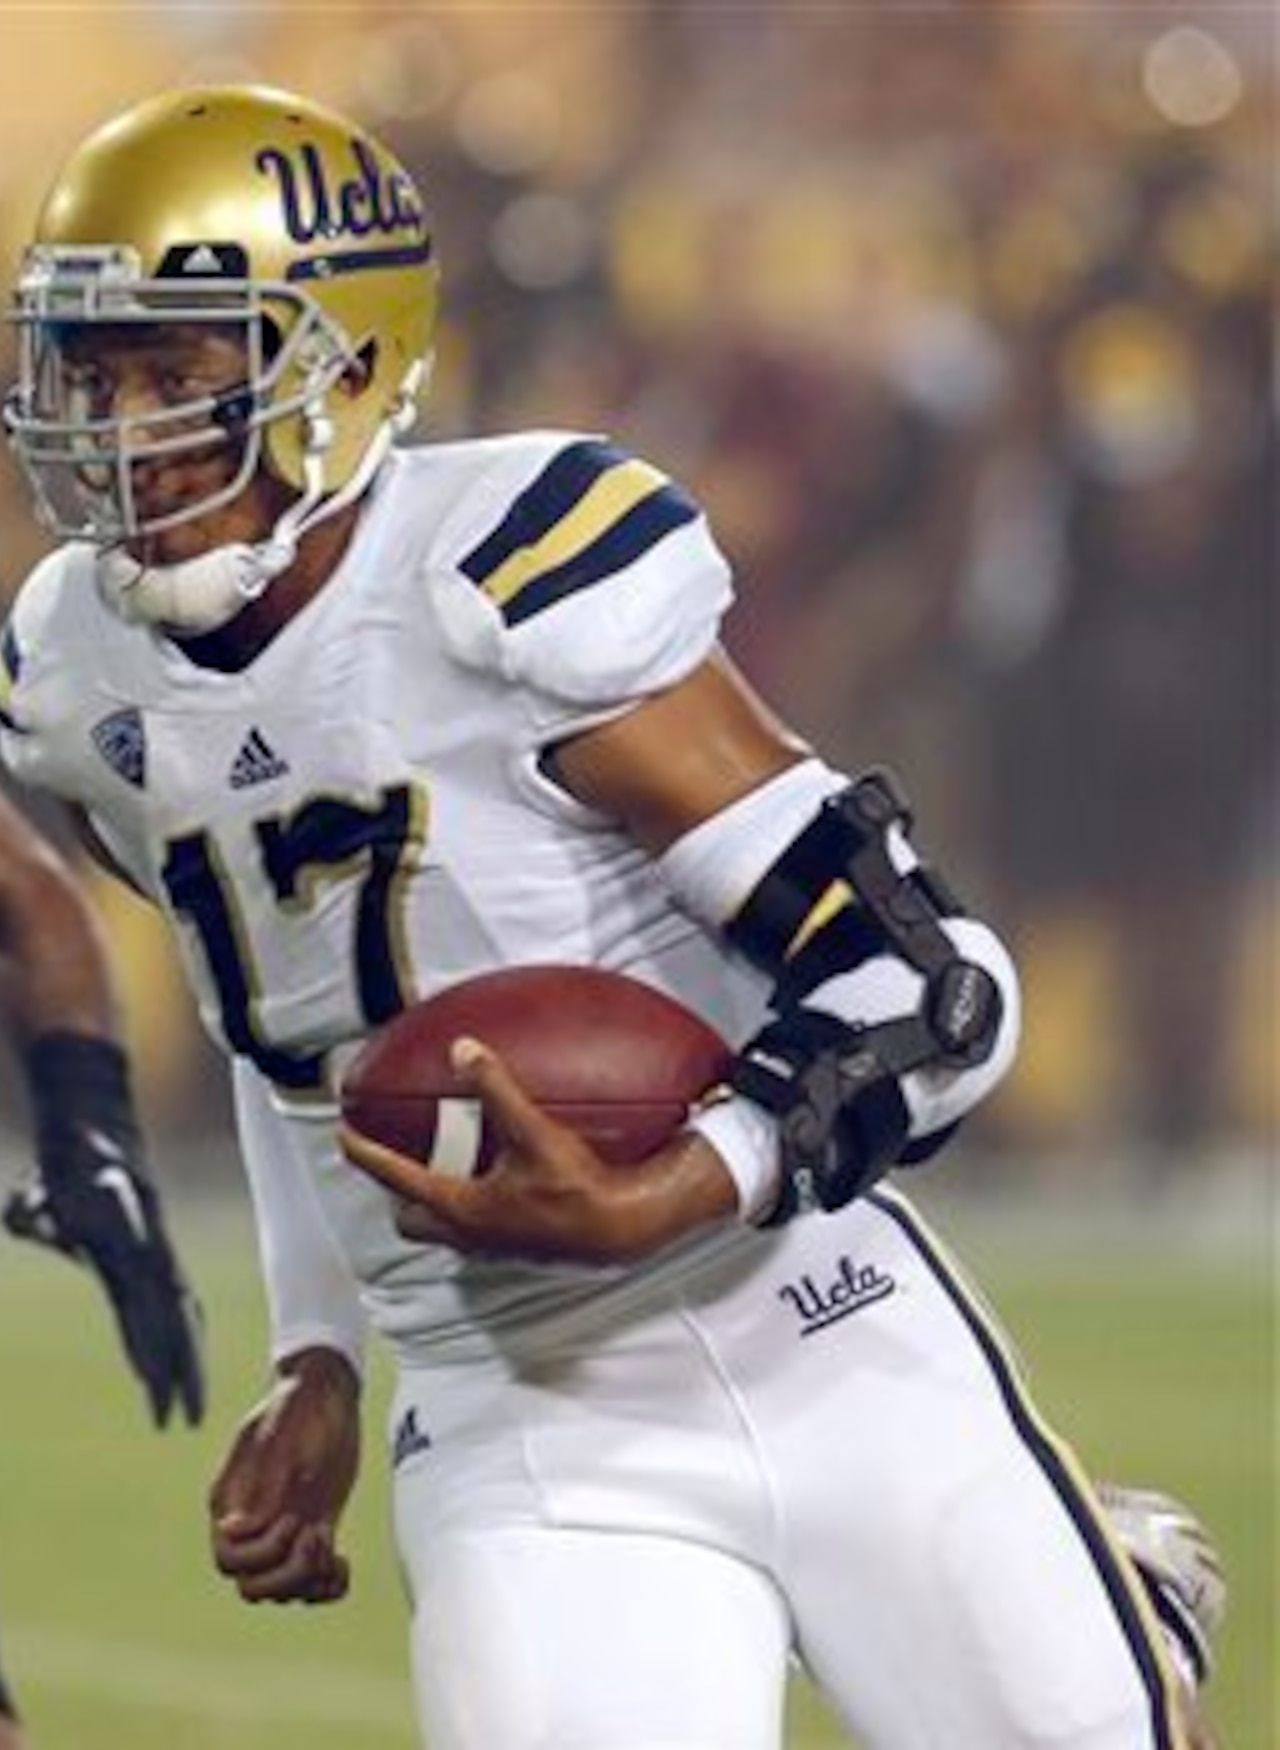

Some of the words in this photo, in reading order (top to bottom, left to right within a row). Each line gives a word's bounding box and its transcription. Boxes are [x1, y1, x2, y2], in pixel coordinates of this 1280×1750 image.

[256, 136, 431, 282] Ucla
[160, 776, 428, 1108] 17
[779, 1255, 896, 1338] Ucla
